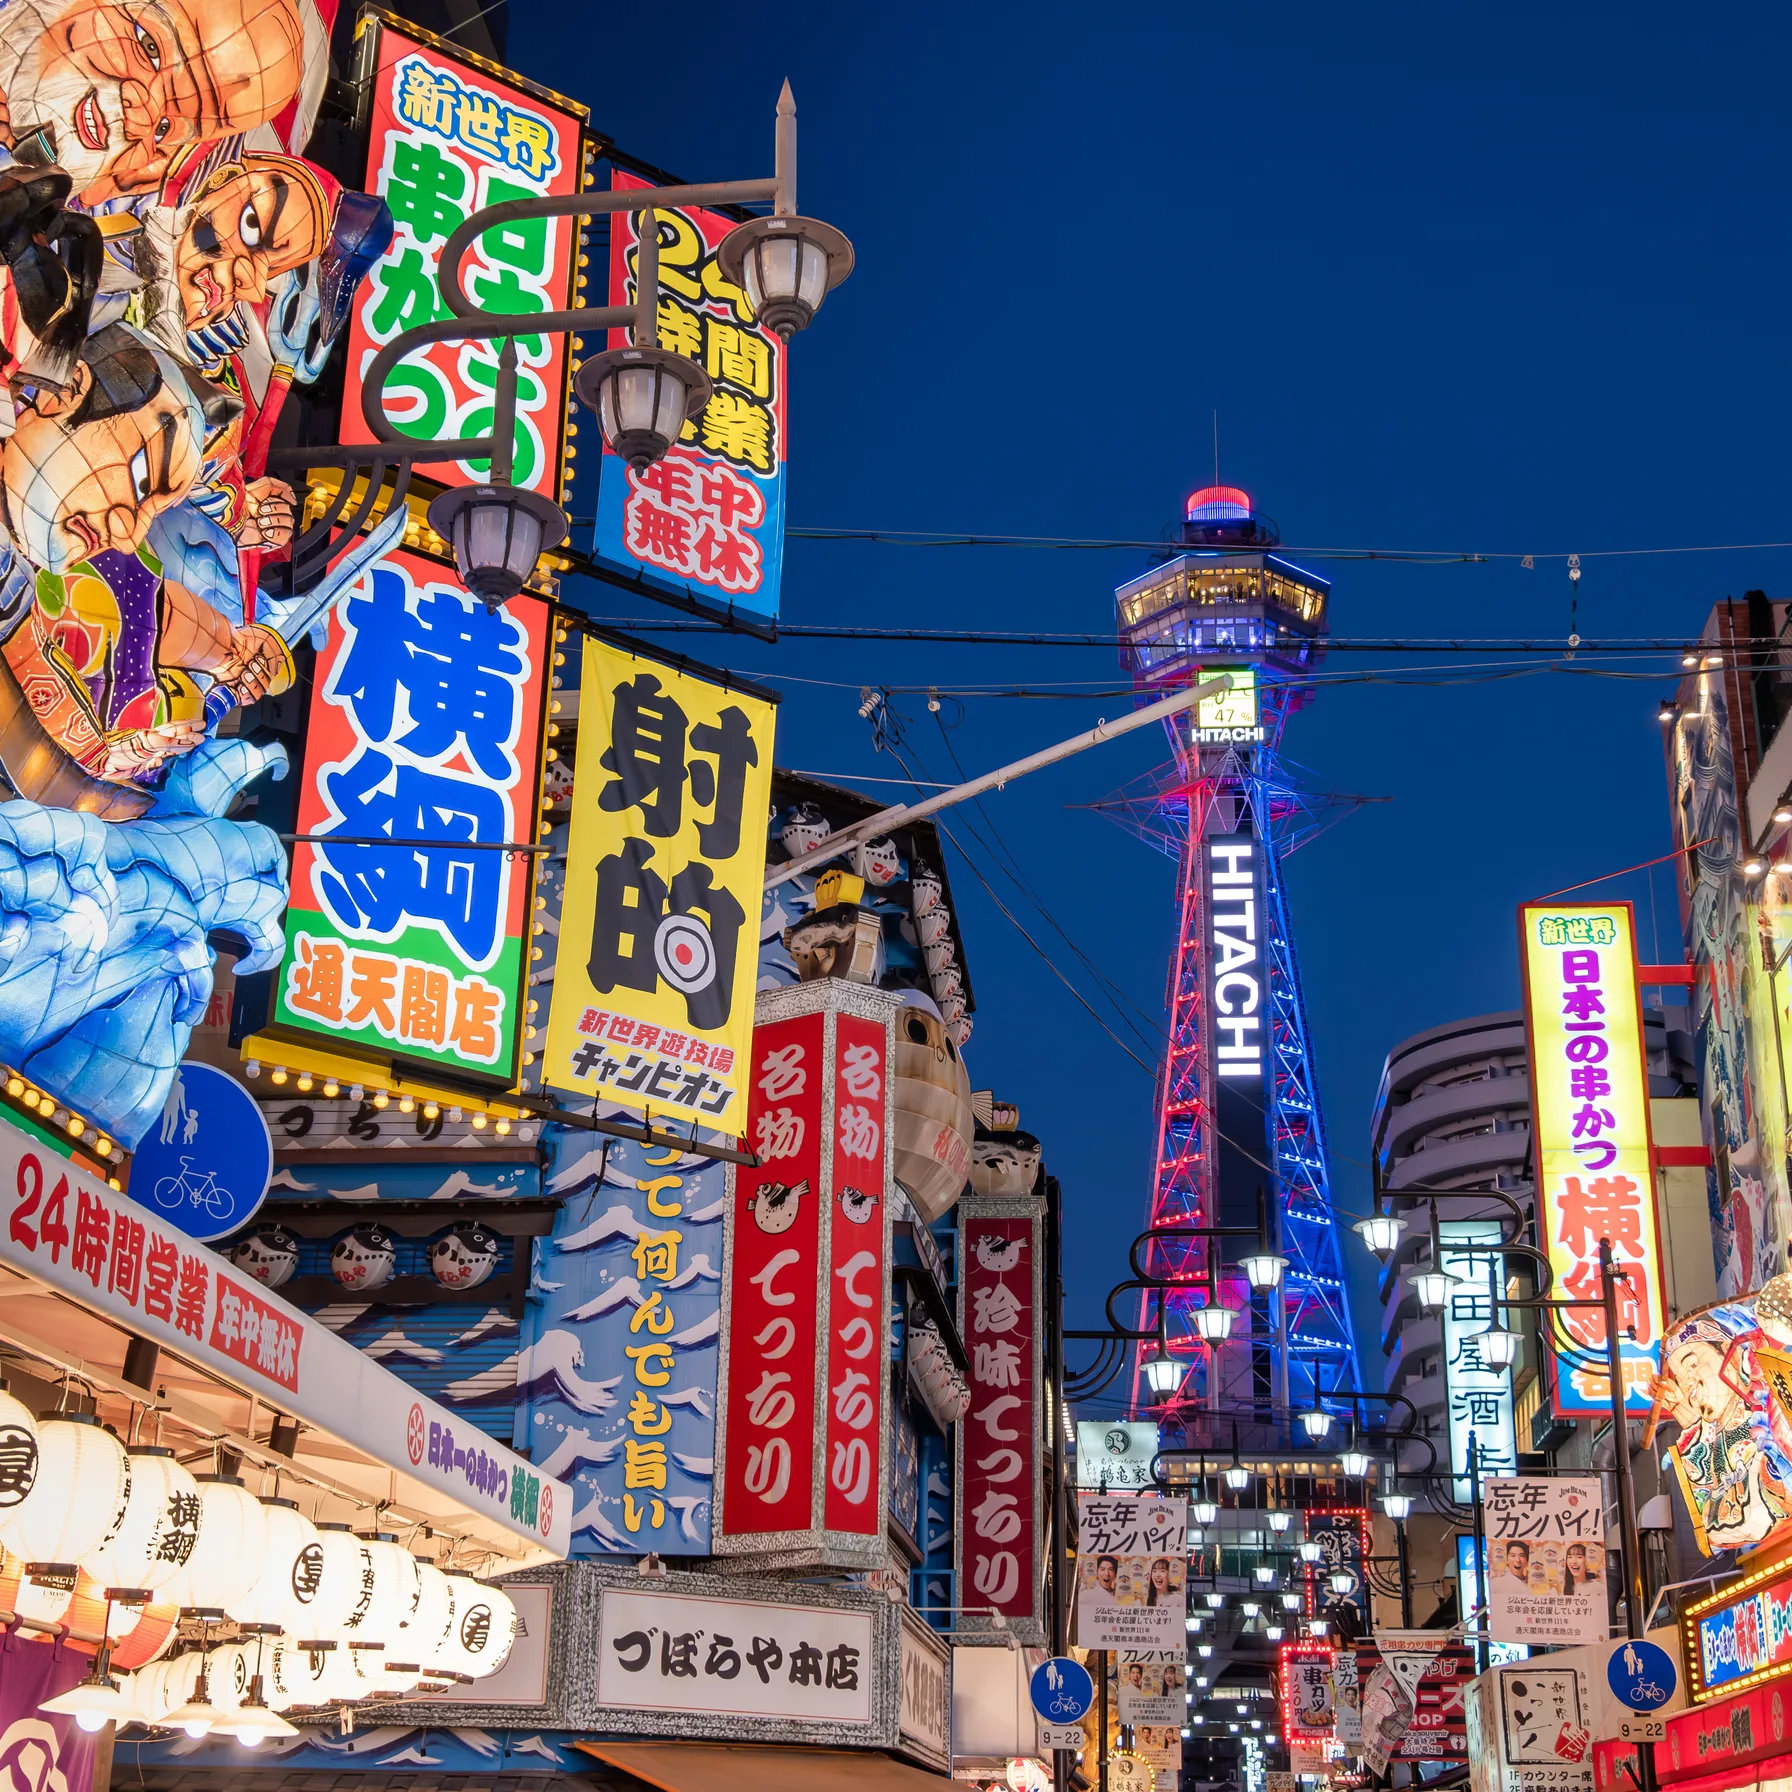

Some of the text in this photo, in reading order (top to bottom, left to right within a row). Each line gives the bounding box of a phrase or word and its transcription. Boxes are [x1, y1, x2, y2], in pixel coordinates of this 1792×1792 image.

[402, 62, 554, 182] 新世界
[639, 503, 756, 586] 無休
[1191, 727, 1265, 742] HITACHI
[1214, 709, 1235, 723] 47
[317, 568, 521, 961] 横綱
[586, 674, 758, 1030] 射的
[1210, 844, 1262, 1077] HITACHI
[1539, 915, 1617, 947] 新世界
[292, 938, 499, 1060] 通天閣店
[578, 1008, 735, 1074] 新世界遊技場
[1562, 949, 1618, 1171] 日本一の串かつ
[571, 1042, 734, 1115] チャンピオン
[756, 1043, 808, 1163] 名物
[840, 1042, 880, 1162] 名物
[9, 1152, 208, 1342] 24時間営業
[1557, 1174, 1652, 1345] 横綱
[217, 1285, 297, 1382] 年中無休
[428, 1420, 508, 1504] 日本一の串かつ
[1559, 1485, 1587, 1498] JIM BEAM
[156, 1490, 200, 1567] 横綱
[510, 1463, 540, 1531] 横綱
[1081, 1502, 1139, 1529] 忘年
[1148, 1505, 1174, 1517] JIM BEAM
[1486, 1483, 1549, 1512] 忘年
[1094, 1615, 1172, 1626] 忘年会を応援しています!
[1095, 1606, 1169, 1617] ジムビームは新世界での
[1506, 1605, 1593, 1617] 忘年会を応援しています!
[1507, 1595, 1588, 1607] ジムビームは新世界での
[613, 1628, 860, 1692] づぼらや本店
[1380, 1640, 1447, 1650] 元祖串カツ専門
[1734, 1600, 1759, 1671] 横綱
[1303, 1665, 1325, 1713] 串カツ
[1509, 1770, 1593, 1782] 1F カウンター席
